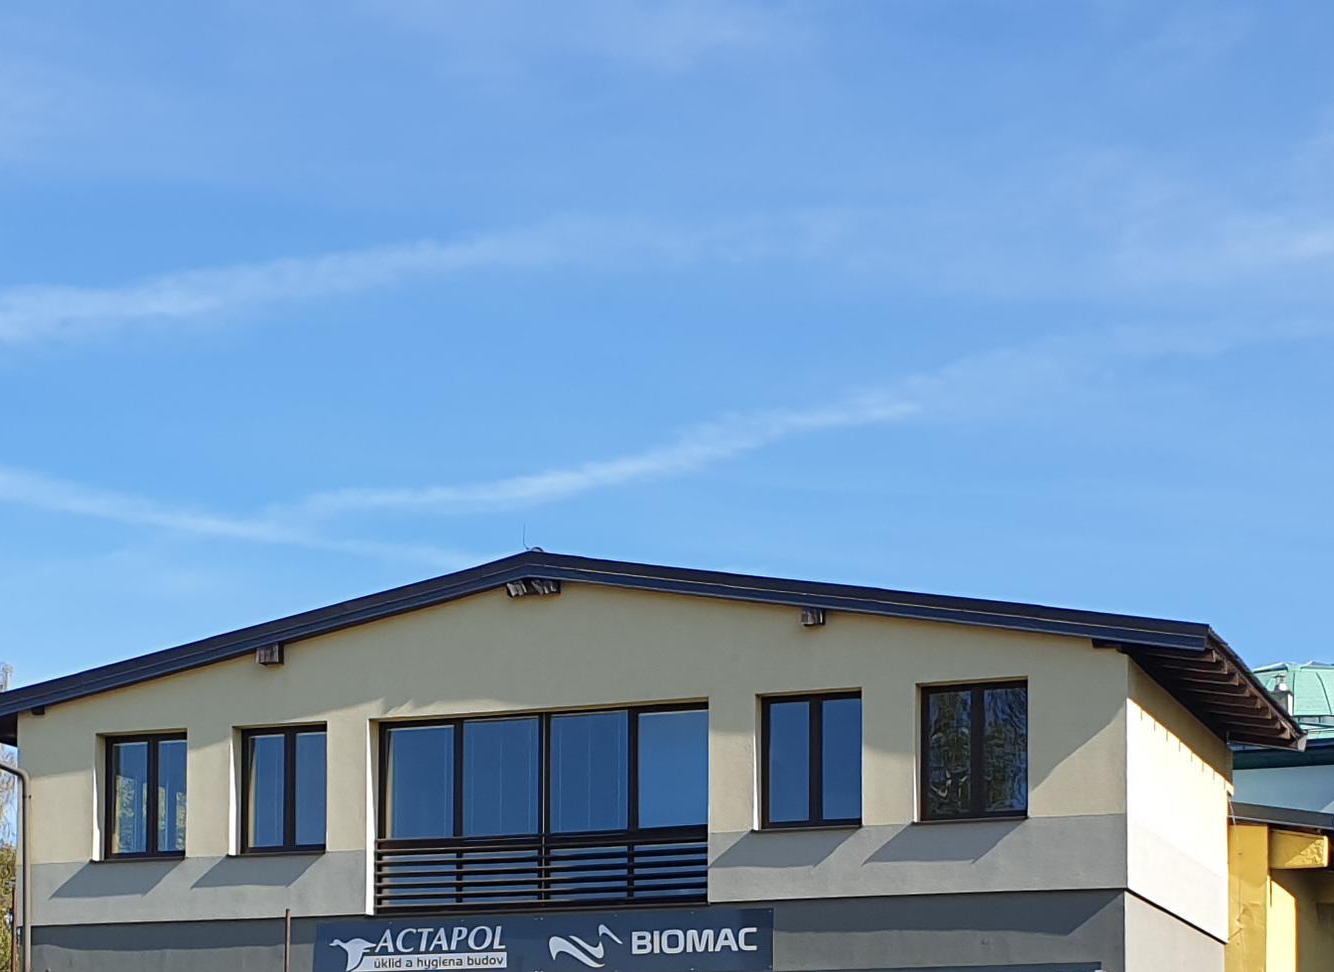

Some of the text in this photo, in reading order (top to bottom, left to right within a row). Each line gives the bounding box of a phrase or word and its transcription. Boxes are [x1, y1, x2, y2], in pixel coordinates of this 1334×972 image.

[374, 925, 506, 953] ACTAPOL
[631, 927, 758, 955] BIOMAC
[405, 959, 413, 968] a
[416, 957, 463, 970] hygiena
[466, 955, 505, 966] budov
